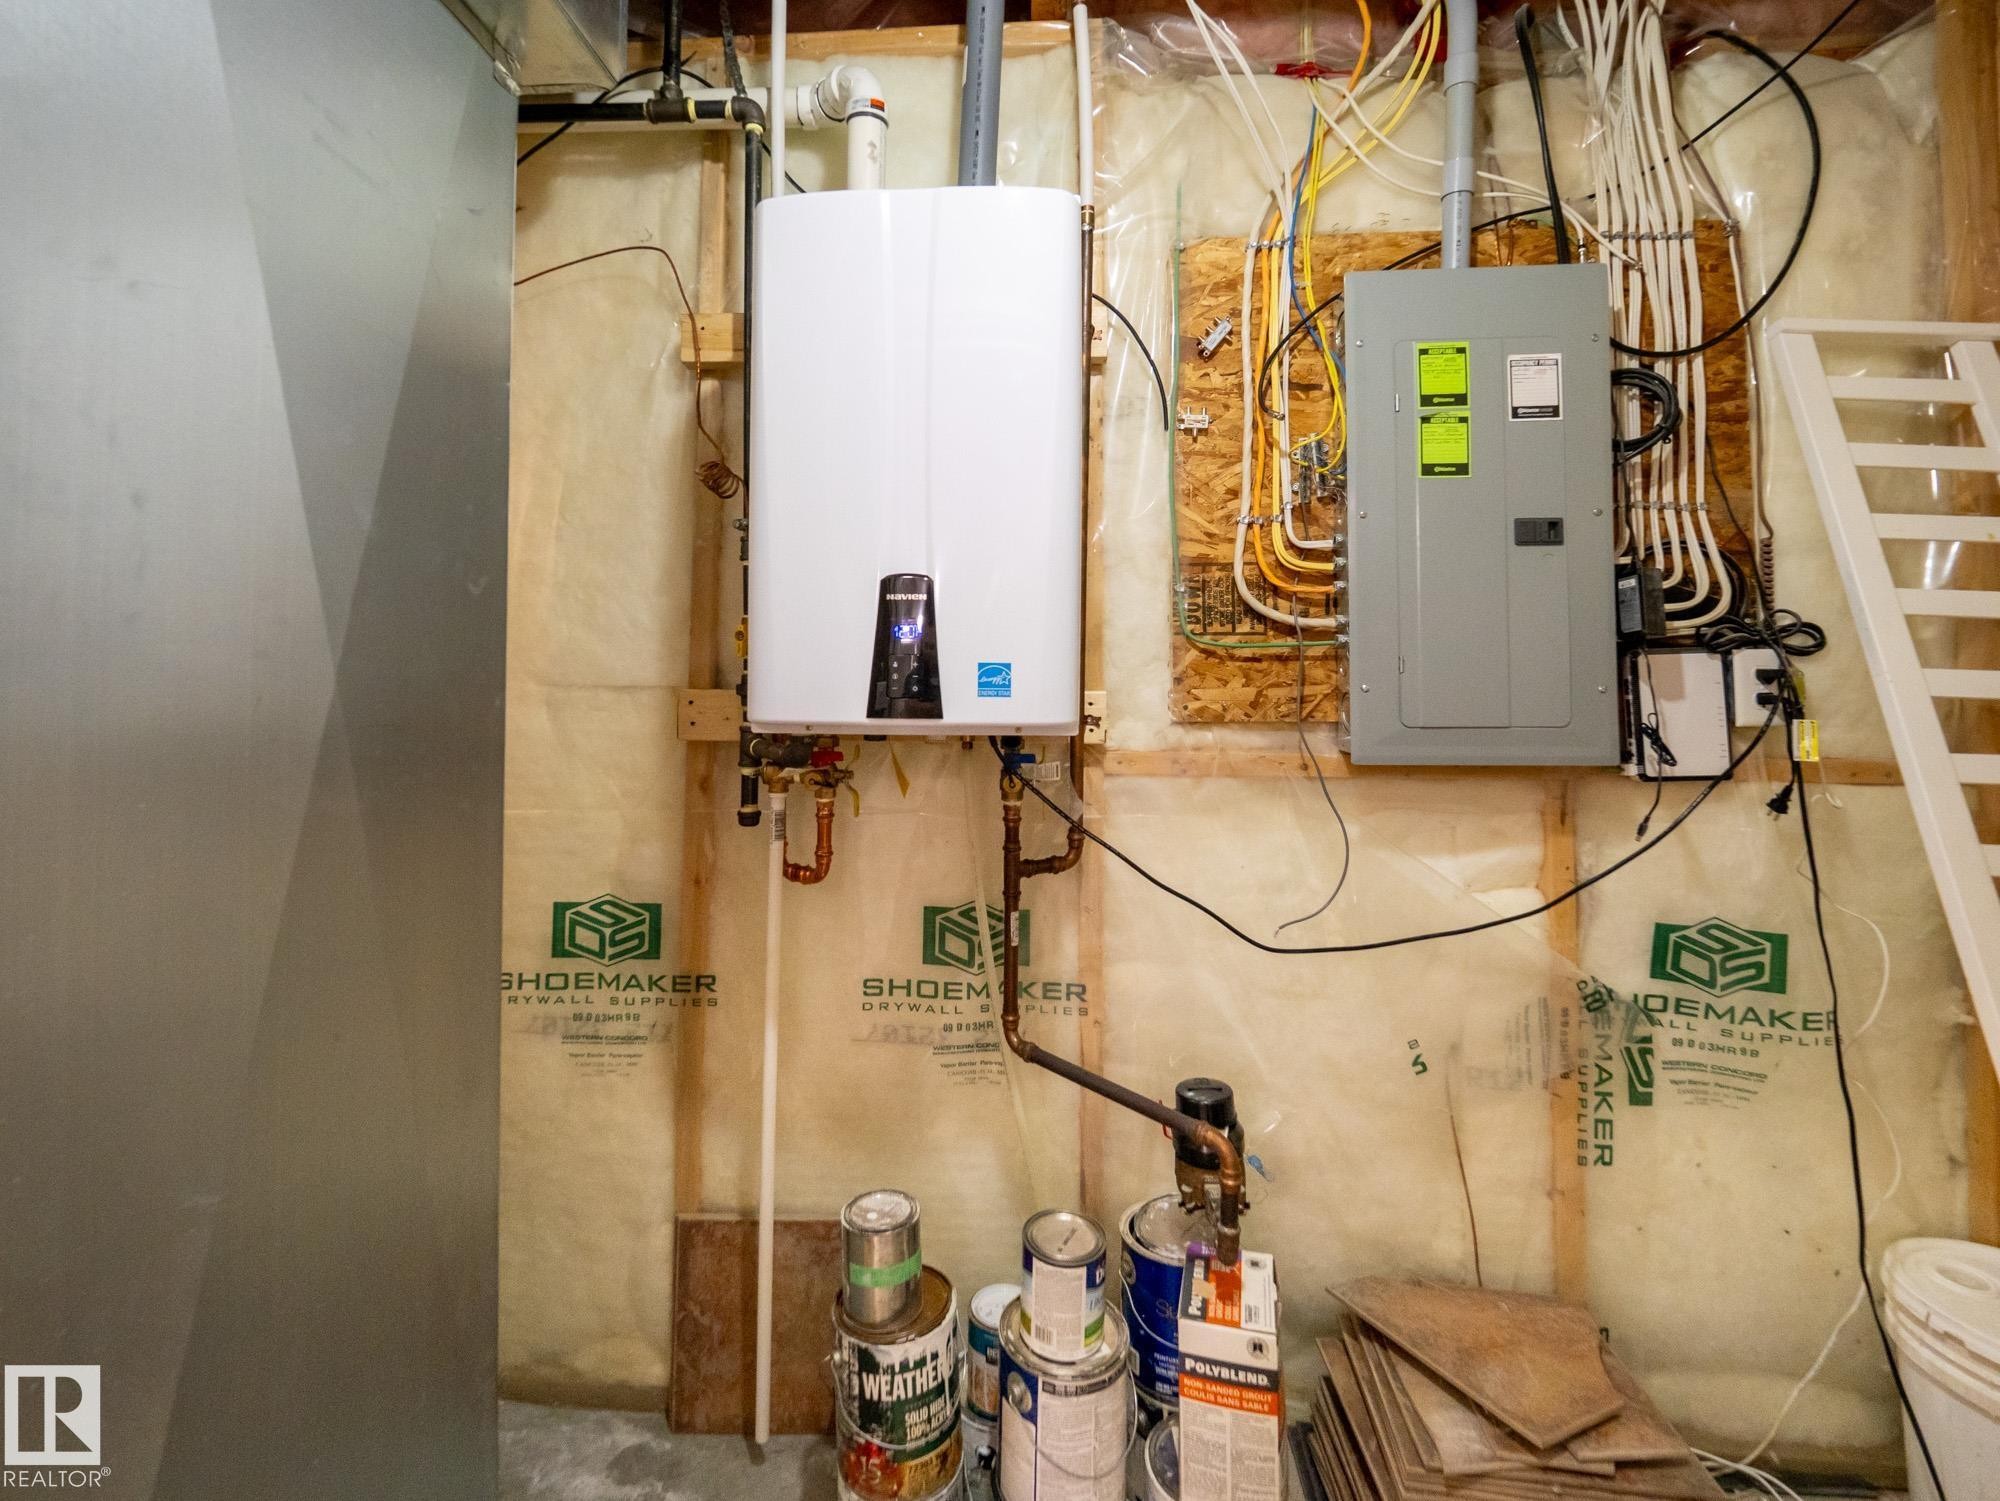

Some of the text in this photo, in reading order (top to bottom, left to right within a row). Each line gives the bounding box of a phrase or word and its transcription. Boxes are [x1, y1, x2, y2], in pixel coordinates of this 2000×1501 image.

[501, 972, 718, 993] SHOEMAKER
[863, 978, 1088, 1002] SHOEMKER
[507, 995, 719, 1008] RYWALL SUPPLIES
[862, 1002, 1089, 1017] DRYWALL SPLIES
[1720, 1027, 1843, 1048] SUPPLIE
[1661, 1060, 1708, 1069] WESTERN
[1709, 1063, 1769, 1079] CONCORD
[1183, 1386, 1270, 1413] COULIS SANS SABLE
[1242, 1390, 1273, 1403] GROUT
[905, 1405, 929, 1426] SOLID
